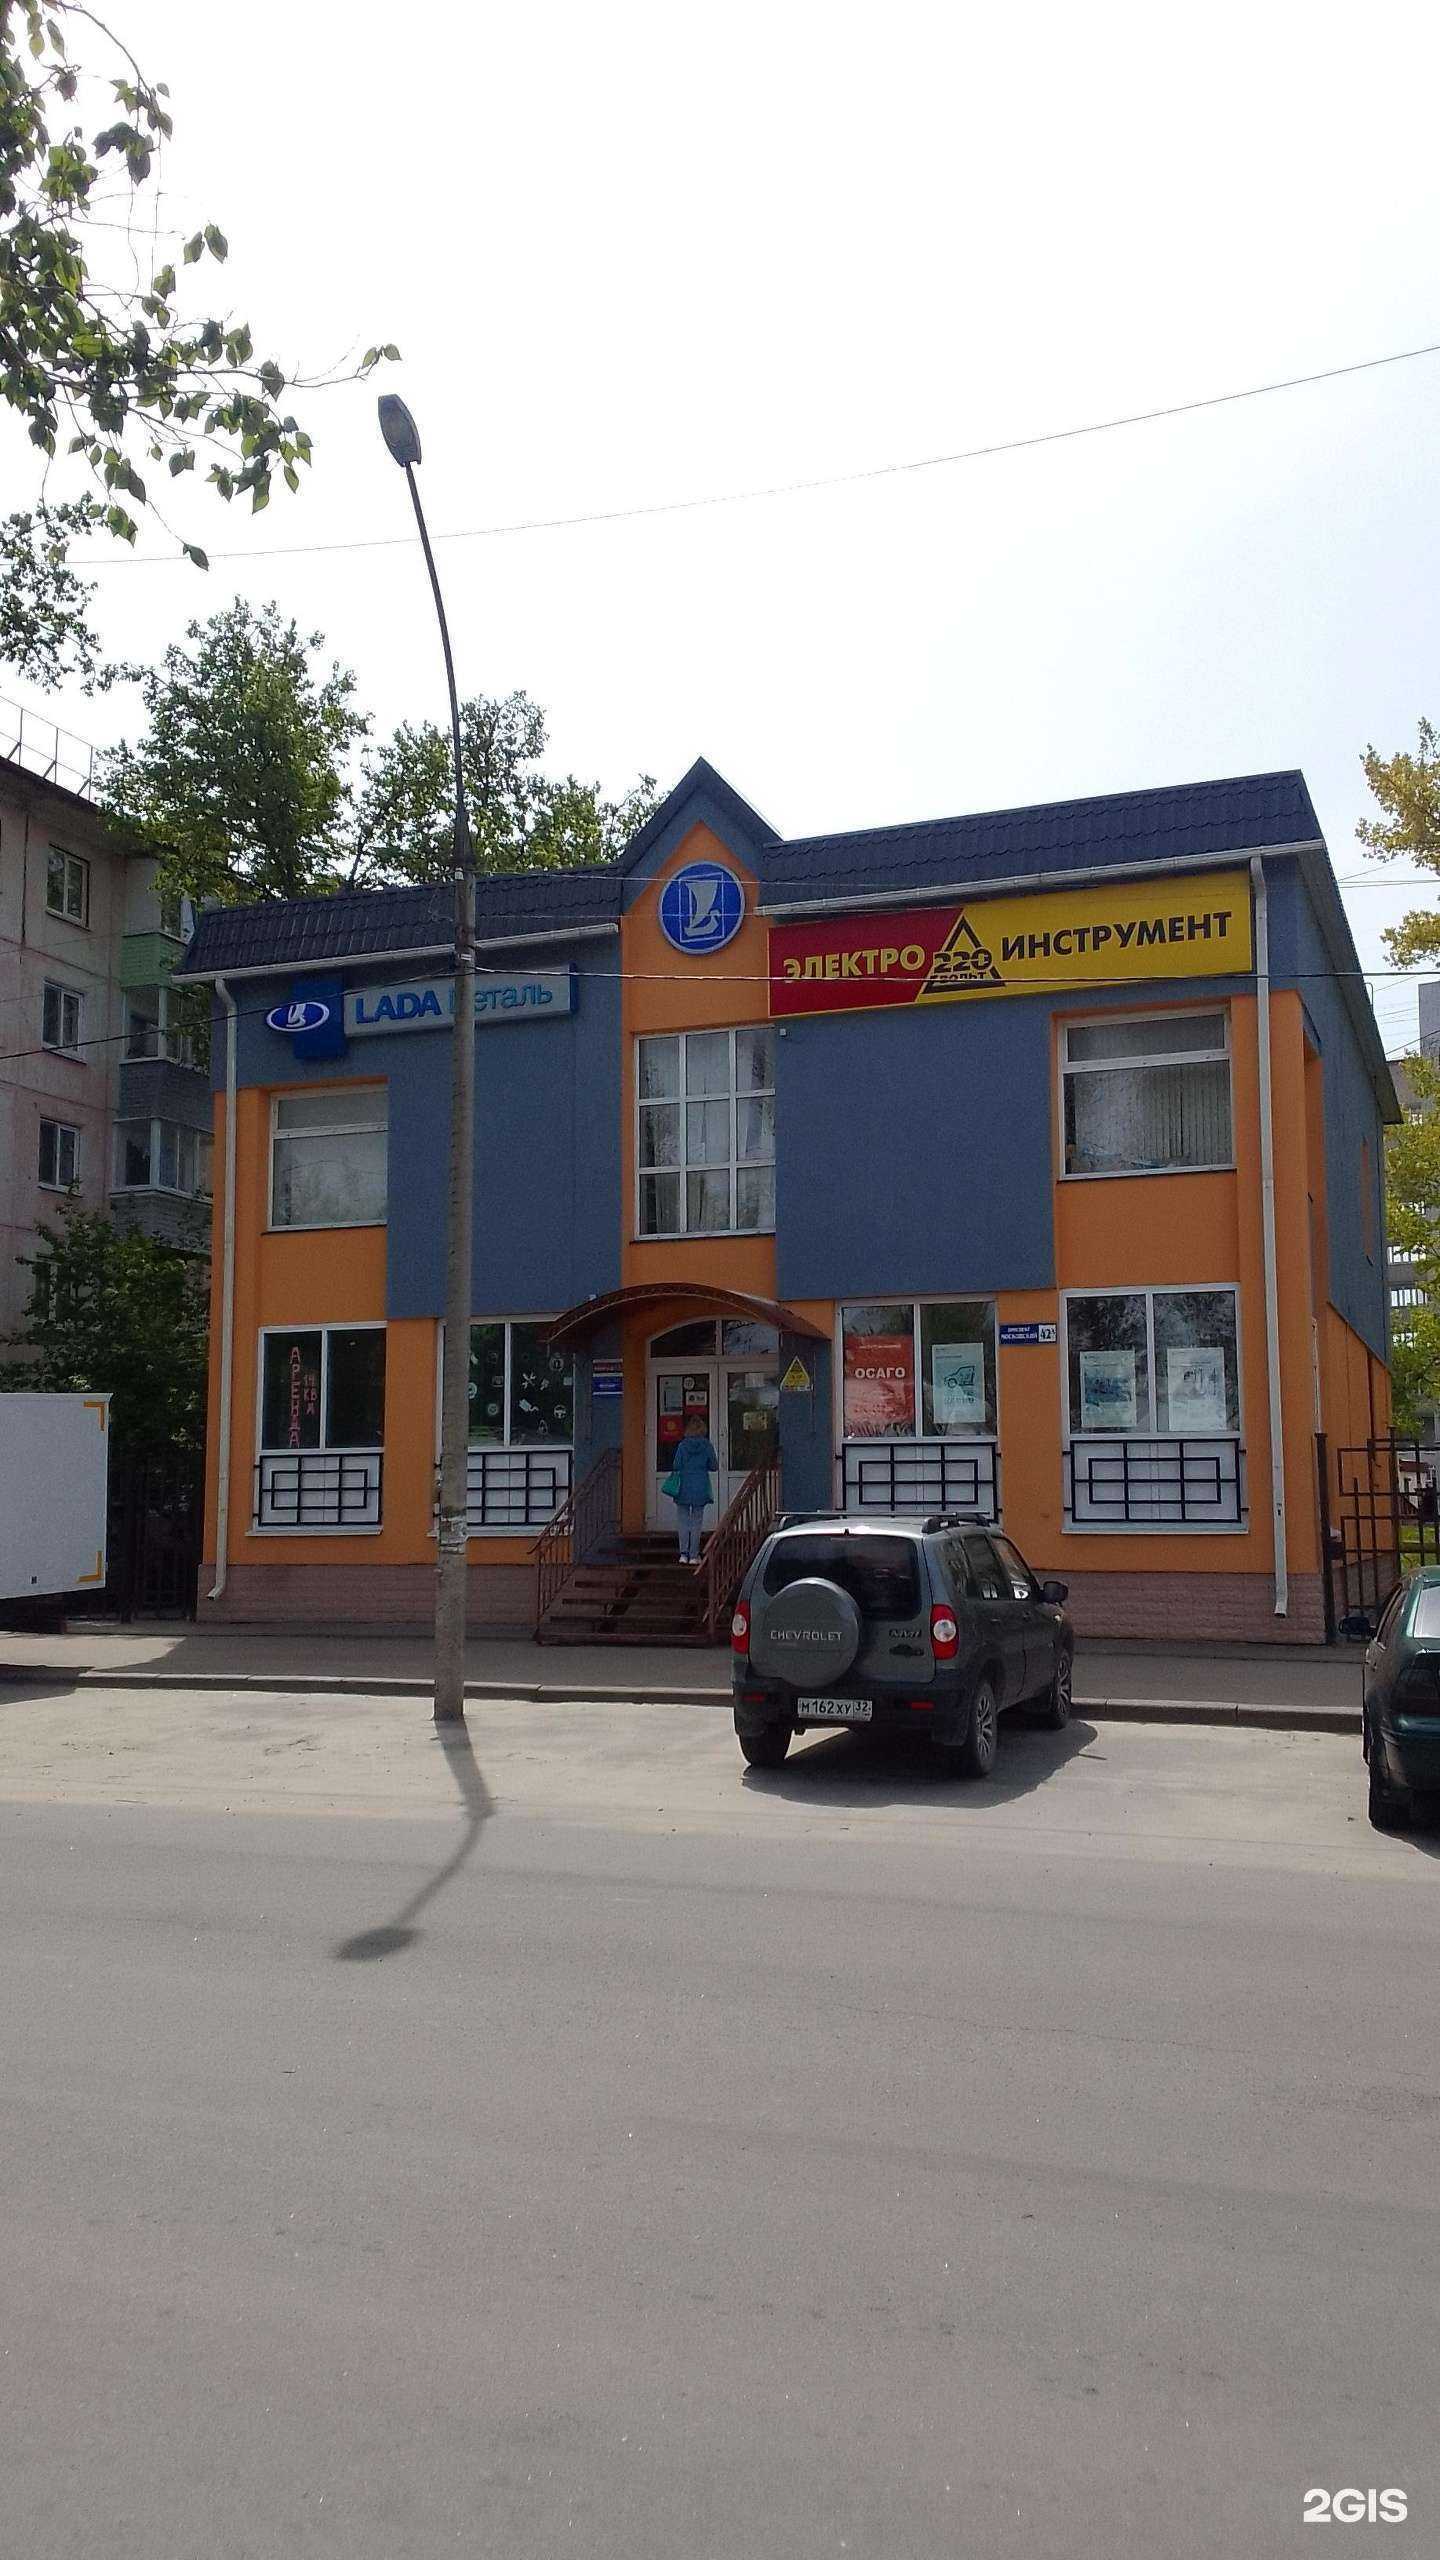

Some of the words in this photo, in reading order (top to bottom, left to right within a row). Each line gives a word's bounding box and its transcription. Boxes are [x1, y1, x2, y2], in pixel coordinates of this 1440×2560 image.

[783, 944, 926, 984] ЭЛЕКТРО
[933, 948, 994, 974] 220
[1001, 910, 1232, 962] ИНСТРУМЕНТ
[355, 990, 442, 1025] LADA
[449, 984, 553, 1014] еталь
[855, 1367, 906, 1379] ОСАГО
[770, 1630, 842, 1641] CHEVROLET
